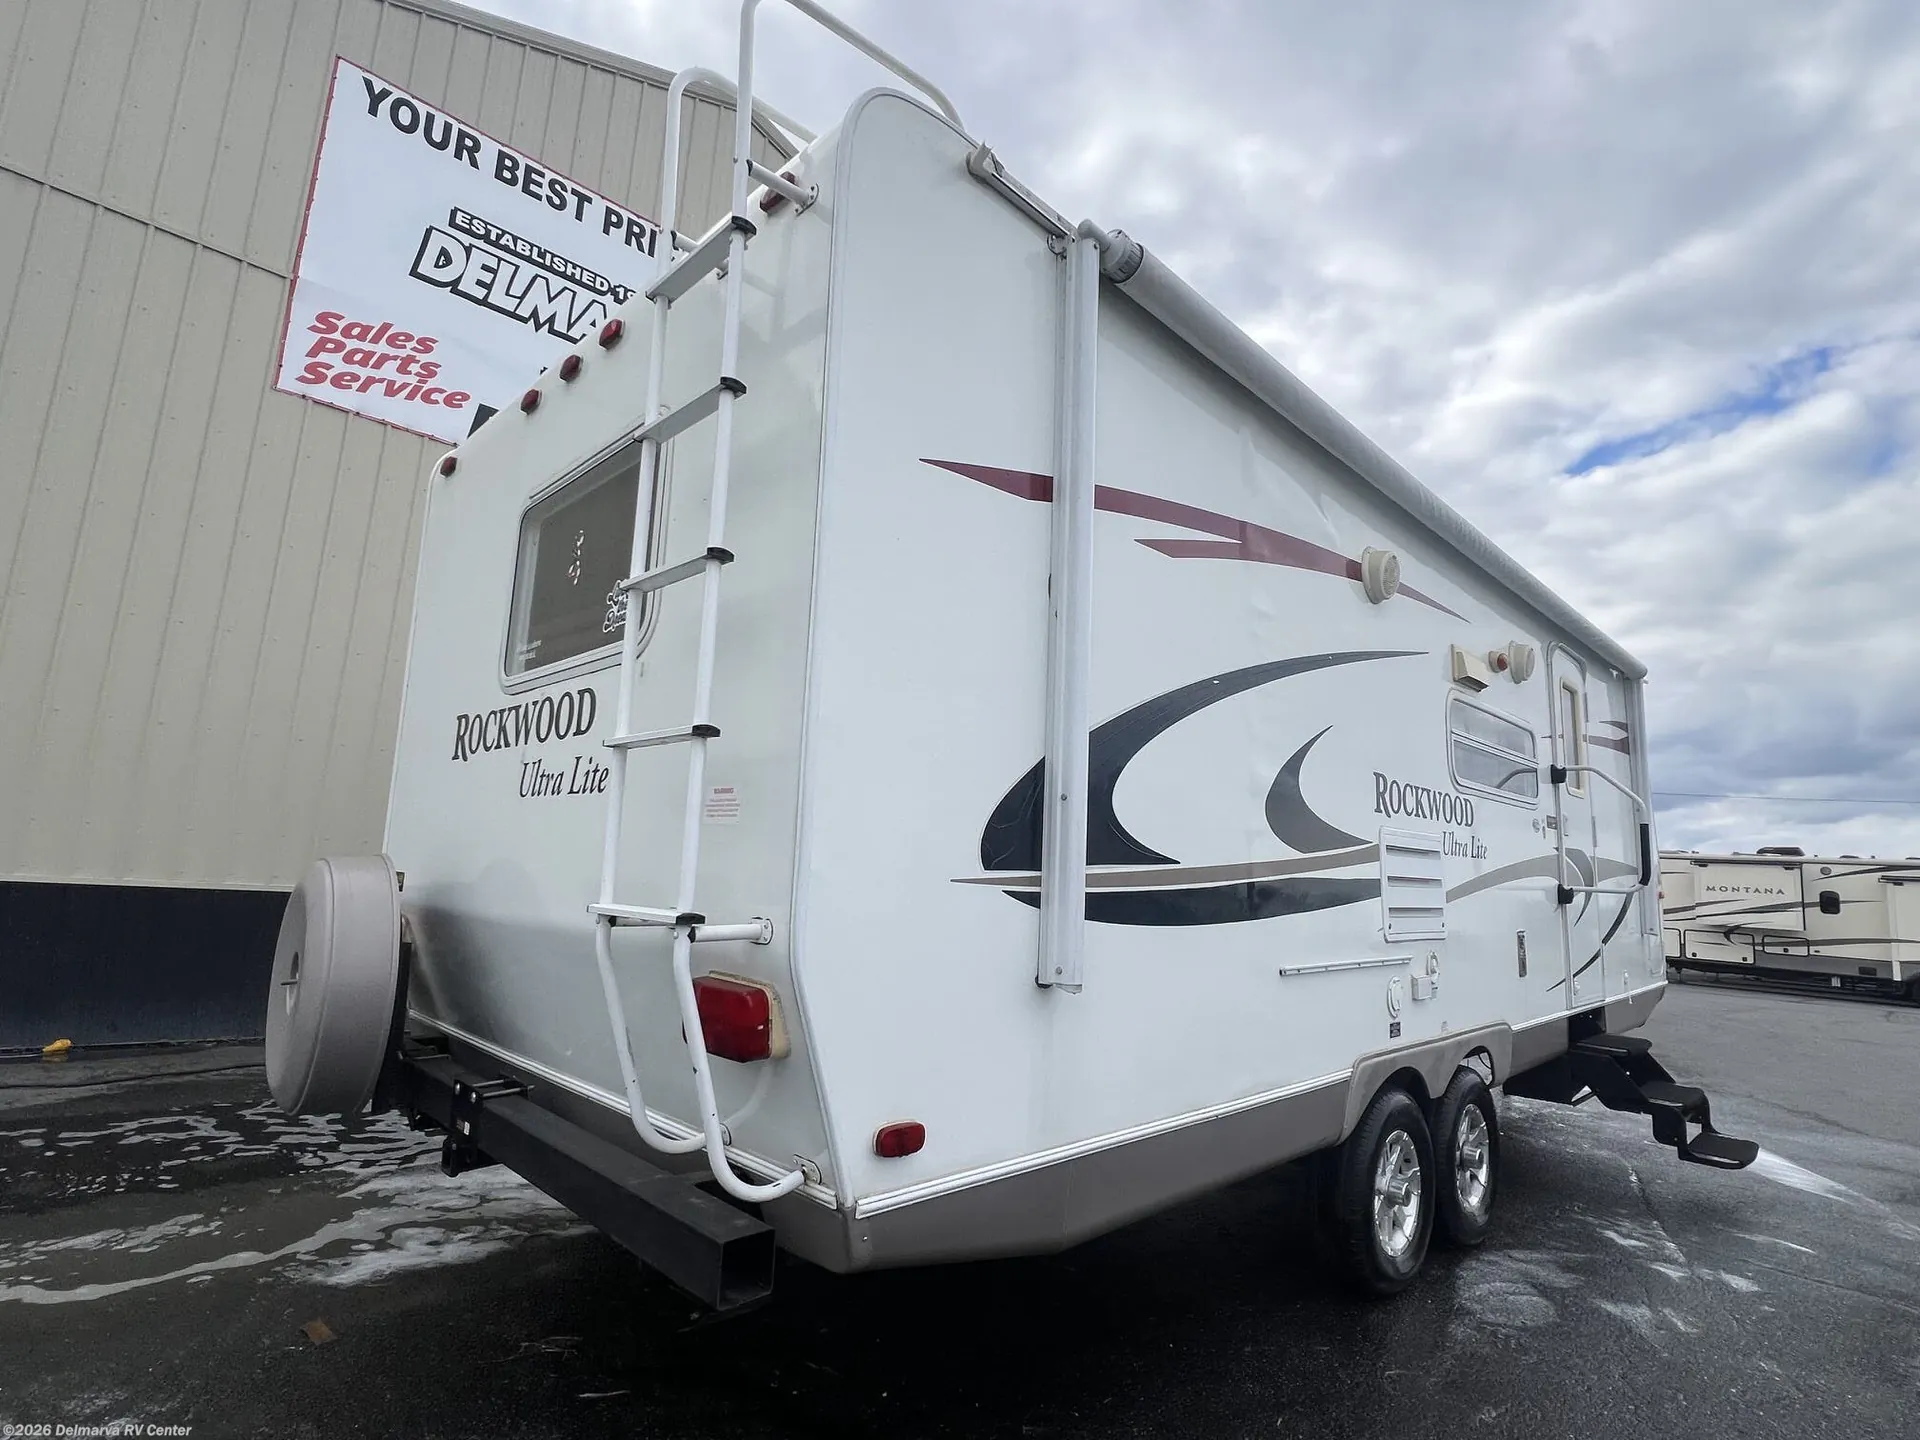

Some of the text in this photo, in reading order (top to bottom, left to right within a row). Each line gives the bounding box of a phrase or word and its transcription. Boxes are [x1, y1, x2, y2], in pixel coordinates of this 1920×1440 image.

[362, 75, 661, 258] YOUR BEST PRI
[453, 209, 612, 294] ESTABLISHED
[307, 311, 439, 354] Sales
[305, 336, 442, 379] Parts
[295, 361, 471, 409] Service
[451, 687, 597, 762] ROCKWOOD
[519, 755, 610, 798] Ultra Lite
[1373, 771, 1474, 827] ROCKWOOD
[1442, 831, 1488, 860] Ultra Lite
[1706, 885, 1785, 895] MONTANA
